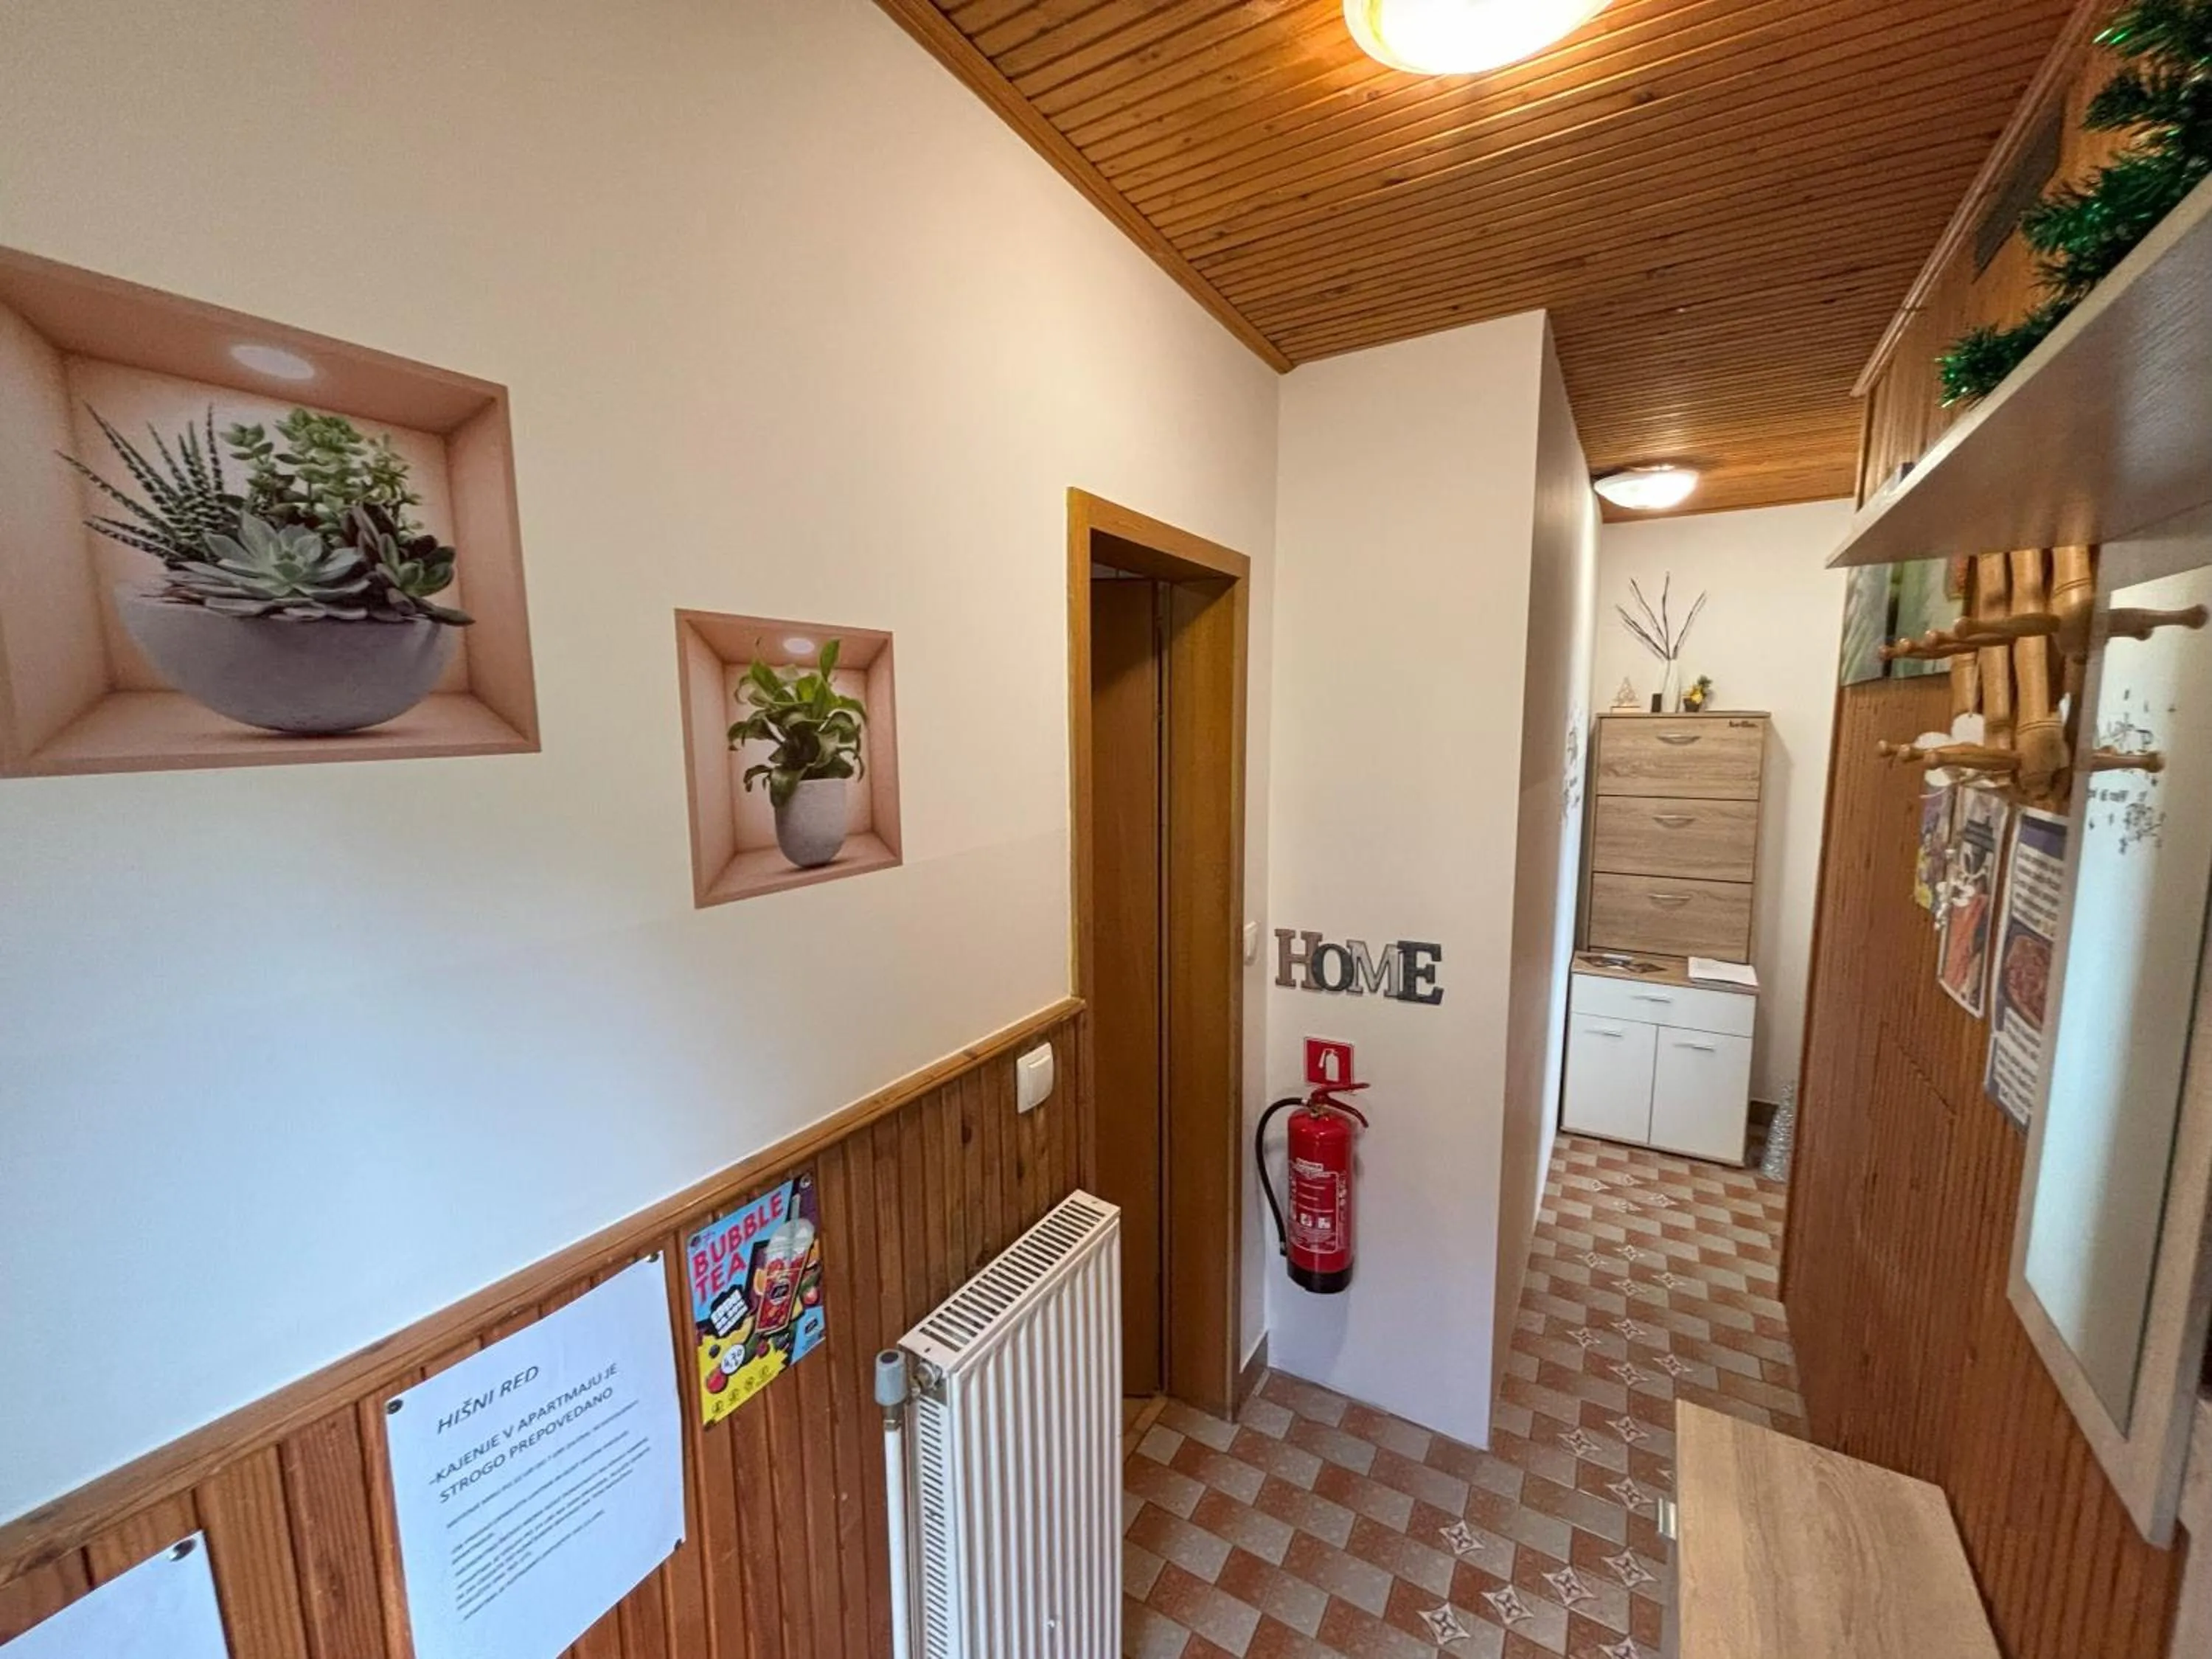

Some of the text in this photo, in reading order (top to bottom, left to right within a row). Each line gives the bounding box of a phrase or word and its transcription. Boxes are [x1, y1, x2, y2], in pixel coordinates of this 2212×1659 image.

[1274, 928, 1444, 1005] HOME
[692, 1191, 783, 1277] BUBBLE
[695, 1251, 747, 1304] TEA
[437, 1365, 540, 1435] HIŠNI RED
[503, 1425, 514, 1442] V
[518, 1376, 601, 1433] APARTMAJU
[602, 1363, 618, 1385] JE
[439, 1454, 506, 1503] STROGO
[509, 1386, 614, 1460] PREPOVEDANO
